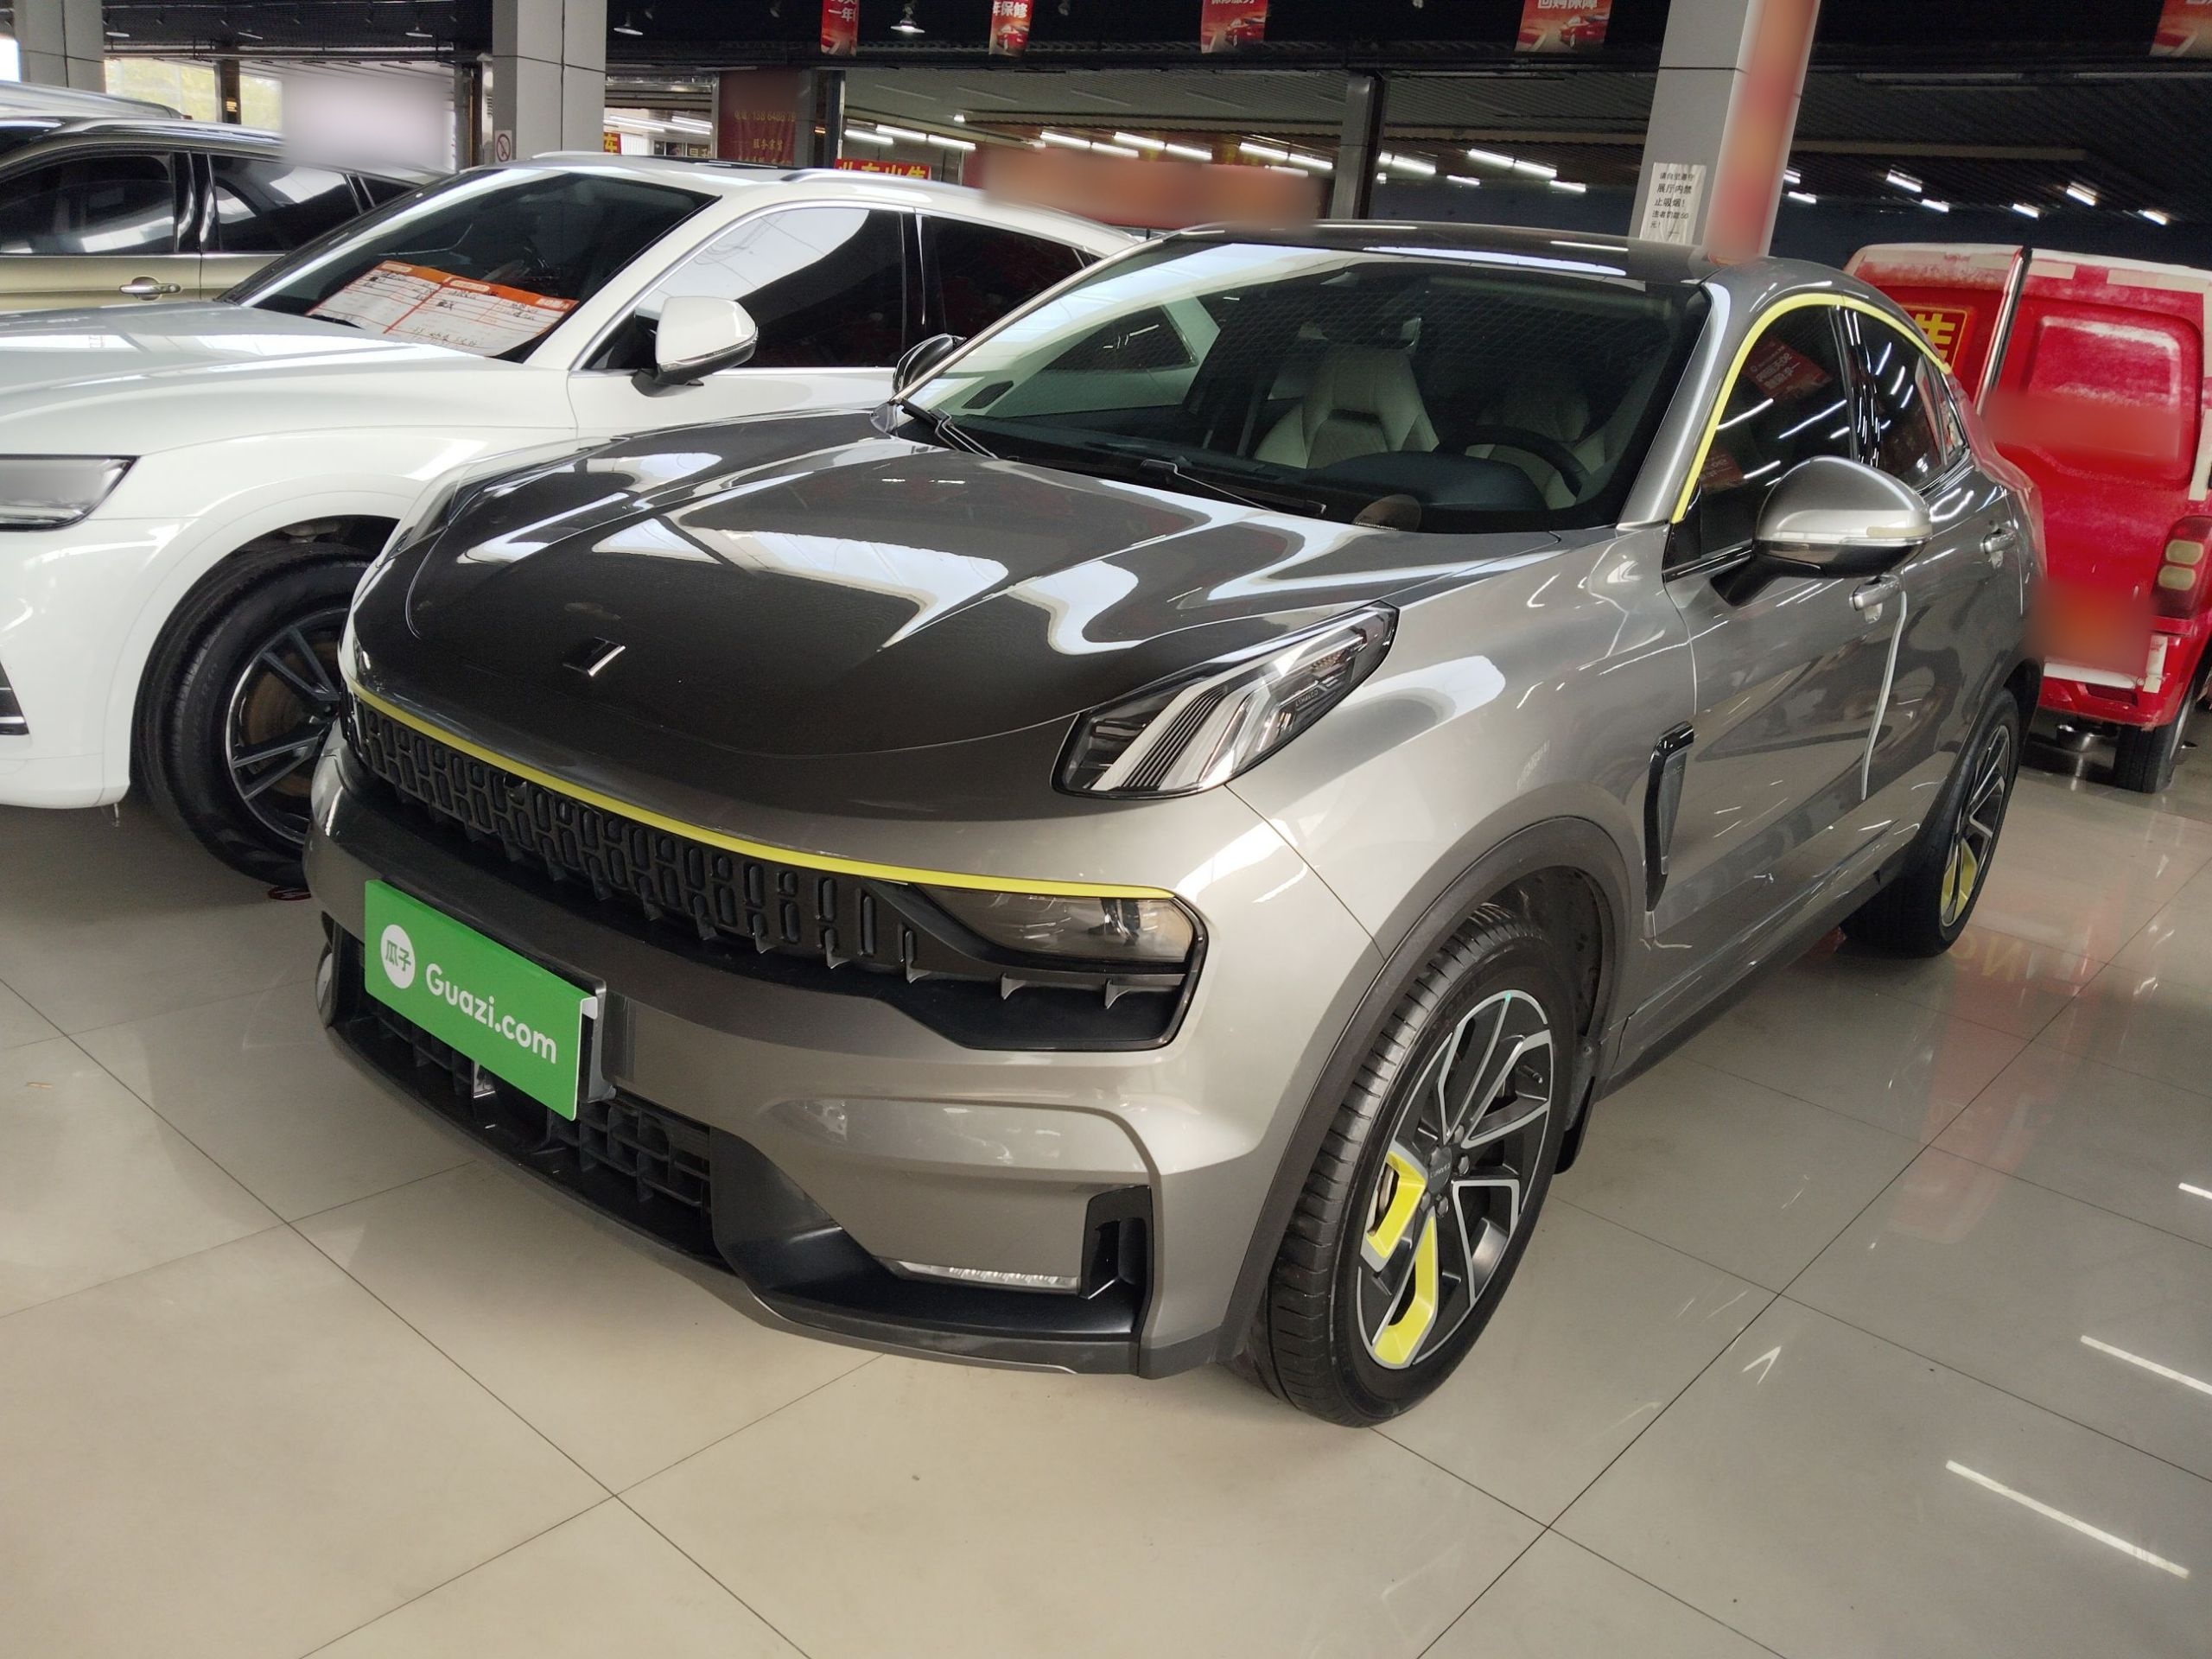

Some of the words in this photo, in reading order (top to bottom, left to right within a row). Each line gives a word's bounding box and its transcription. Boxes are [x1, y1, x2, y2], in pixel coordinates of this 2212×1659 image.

[828, 7, 856, 22] 一年
[1656, 183, 1692, 194] 展厅内禁
[385, 939, 411, 971] 瓜子
[426, 963, 557, 1065] Guazi.com
